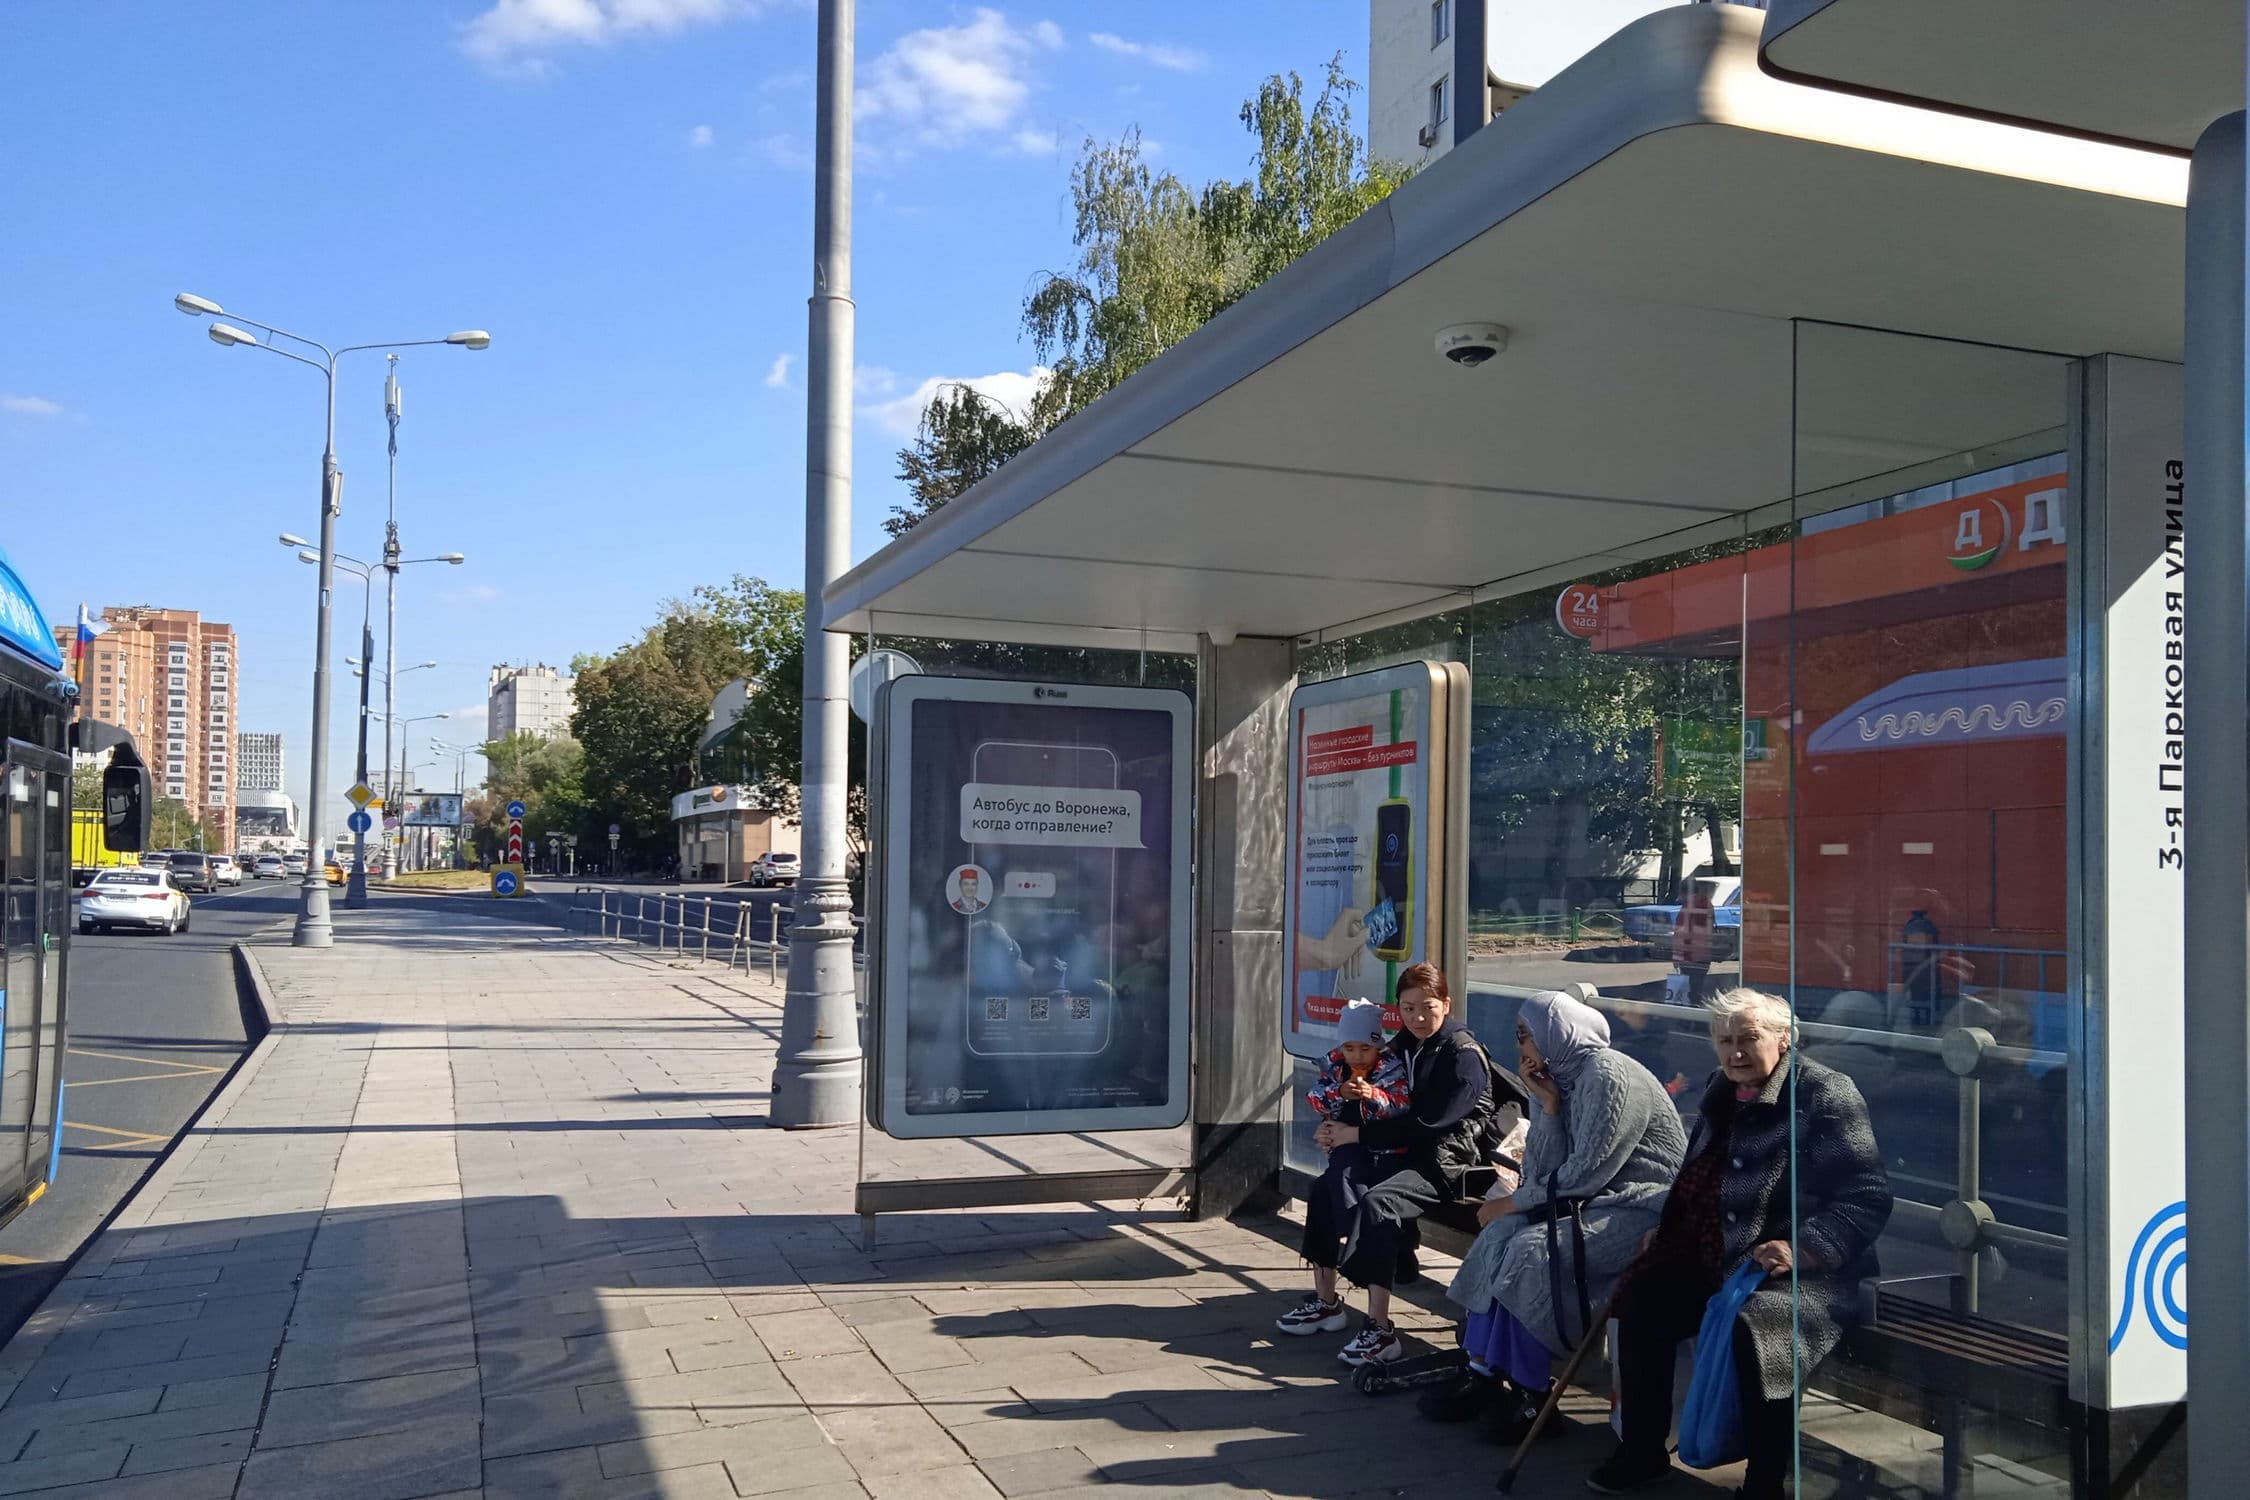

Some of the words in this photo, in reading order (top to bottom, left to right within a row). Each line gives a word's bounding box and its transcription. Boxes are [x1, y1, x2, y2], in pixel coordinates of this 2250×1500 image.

[1954, 508, 1983, 552] Д
[2164, 459, 2185, 579] улица
[1572, 592, 1600, 614] 24
[1572, 616, 1598, 627] часа
[2159, 592, 2185, 791] Парковая
[1367, 751, 1380, 763] без
[972, 797, 1030, 815] Автобус
[1033, 802, 1051, 814] до
[1055, 800, 1131, 817] Воронежа,
[972, 818, 1010, 831] когда
[1015, 820, 1113, 834] отправление?
[2159, 808, 2183, 870] 3-я
